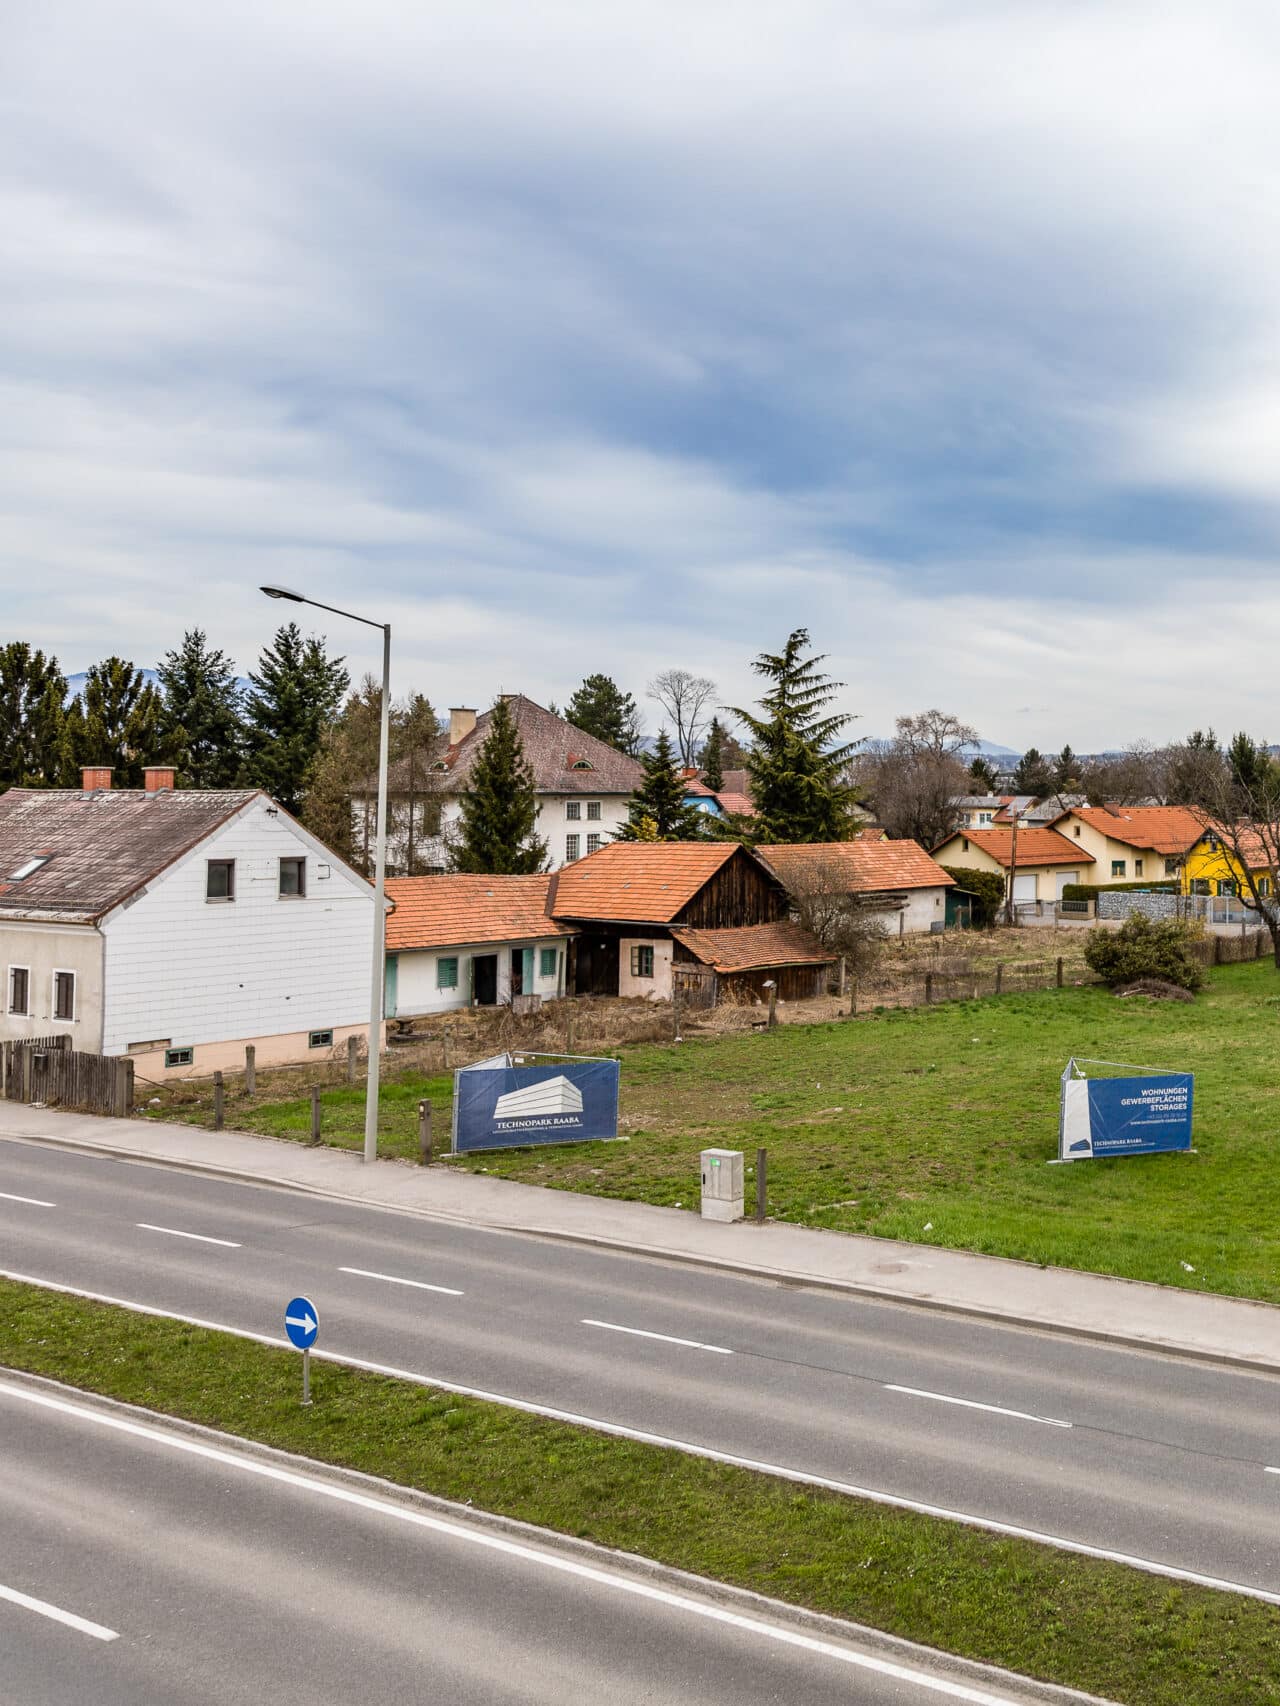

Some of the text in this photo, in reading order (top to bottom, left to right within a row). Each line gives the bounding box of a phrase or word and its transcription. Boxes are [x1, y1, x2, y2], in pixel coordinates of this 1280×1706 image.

[1141, 1087, 1188, 1096] WOHNUNGEN
[1121, 1094, 1188, 1106] GEWERBEFLÄCHEN
[1150, 1103, 1187, 1112] STORAGES
[497, 1118, 553, 1129] TECHNOPARK
[553, 1116, 580, 1125] RAABA
